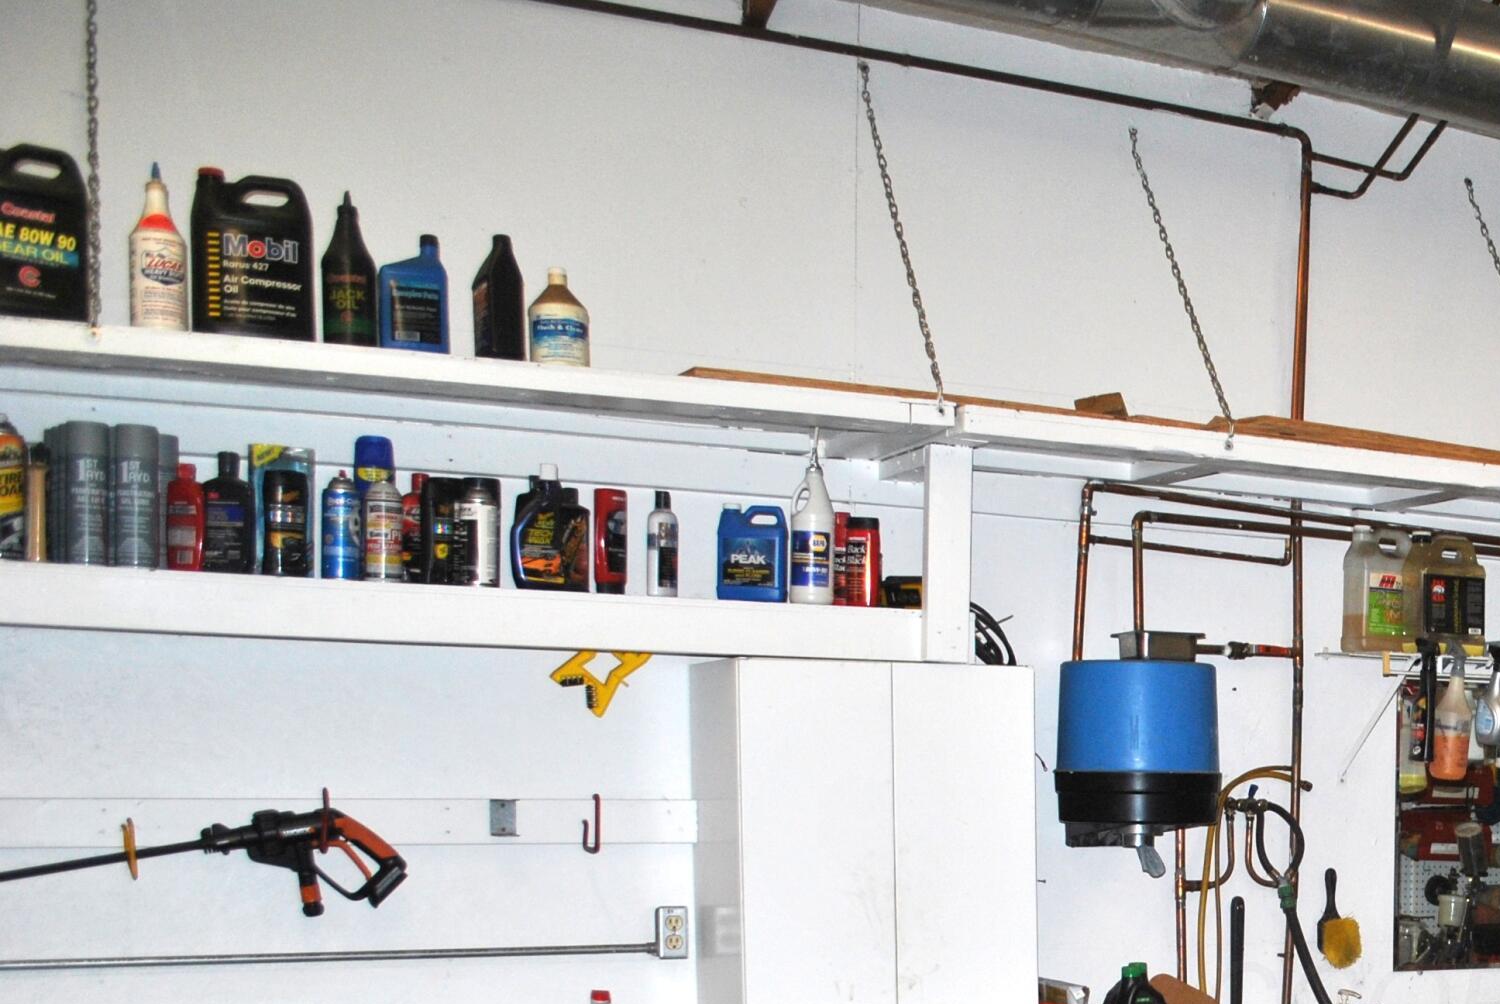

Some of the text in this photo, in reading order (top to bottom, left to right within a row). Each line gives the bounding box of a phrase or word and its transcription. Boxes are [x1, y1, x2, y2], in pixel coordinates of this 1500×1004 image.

[20, 226, 54, 247] 80W
[57, 234, 77, 251] 90
[223, 232, 299, 264] Mobil
[41, 250, 69, 265] OIL
[251, 261, 270, 272] 427
[223, 274, 302, 291] Air Compressor
[223, 284, 239, 294] Oil
[331, 289, 365, 300] JACK
[336, 301, 359, 310] OIL
[730, 553, 766, 565] PEAK
